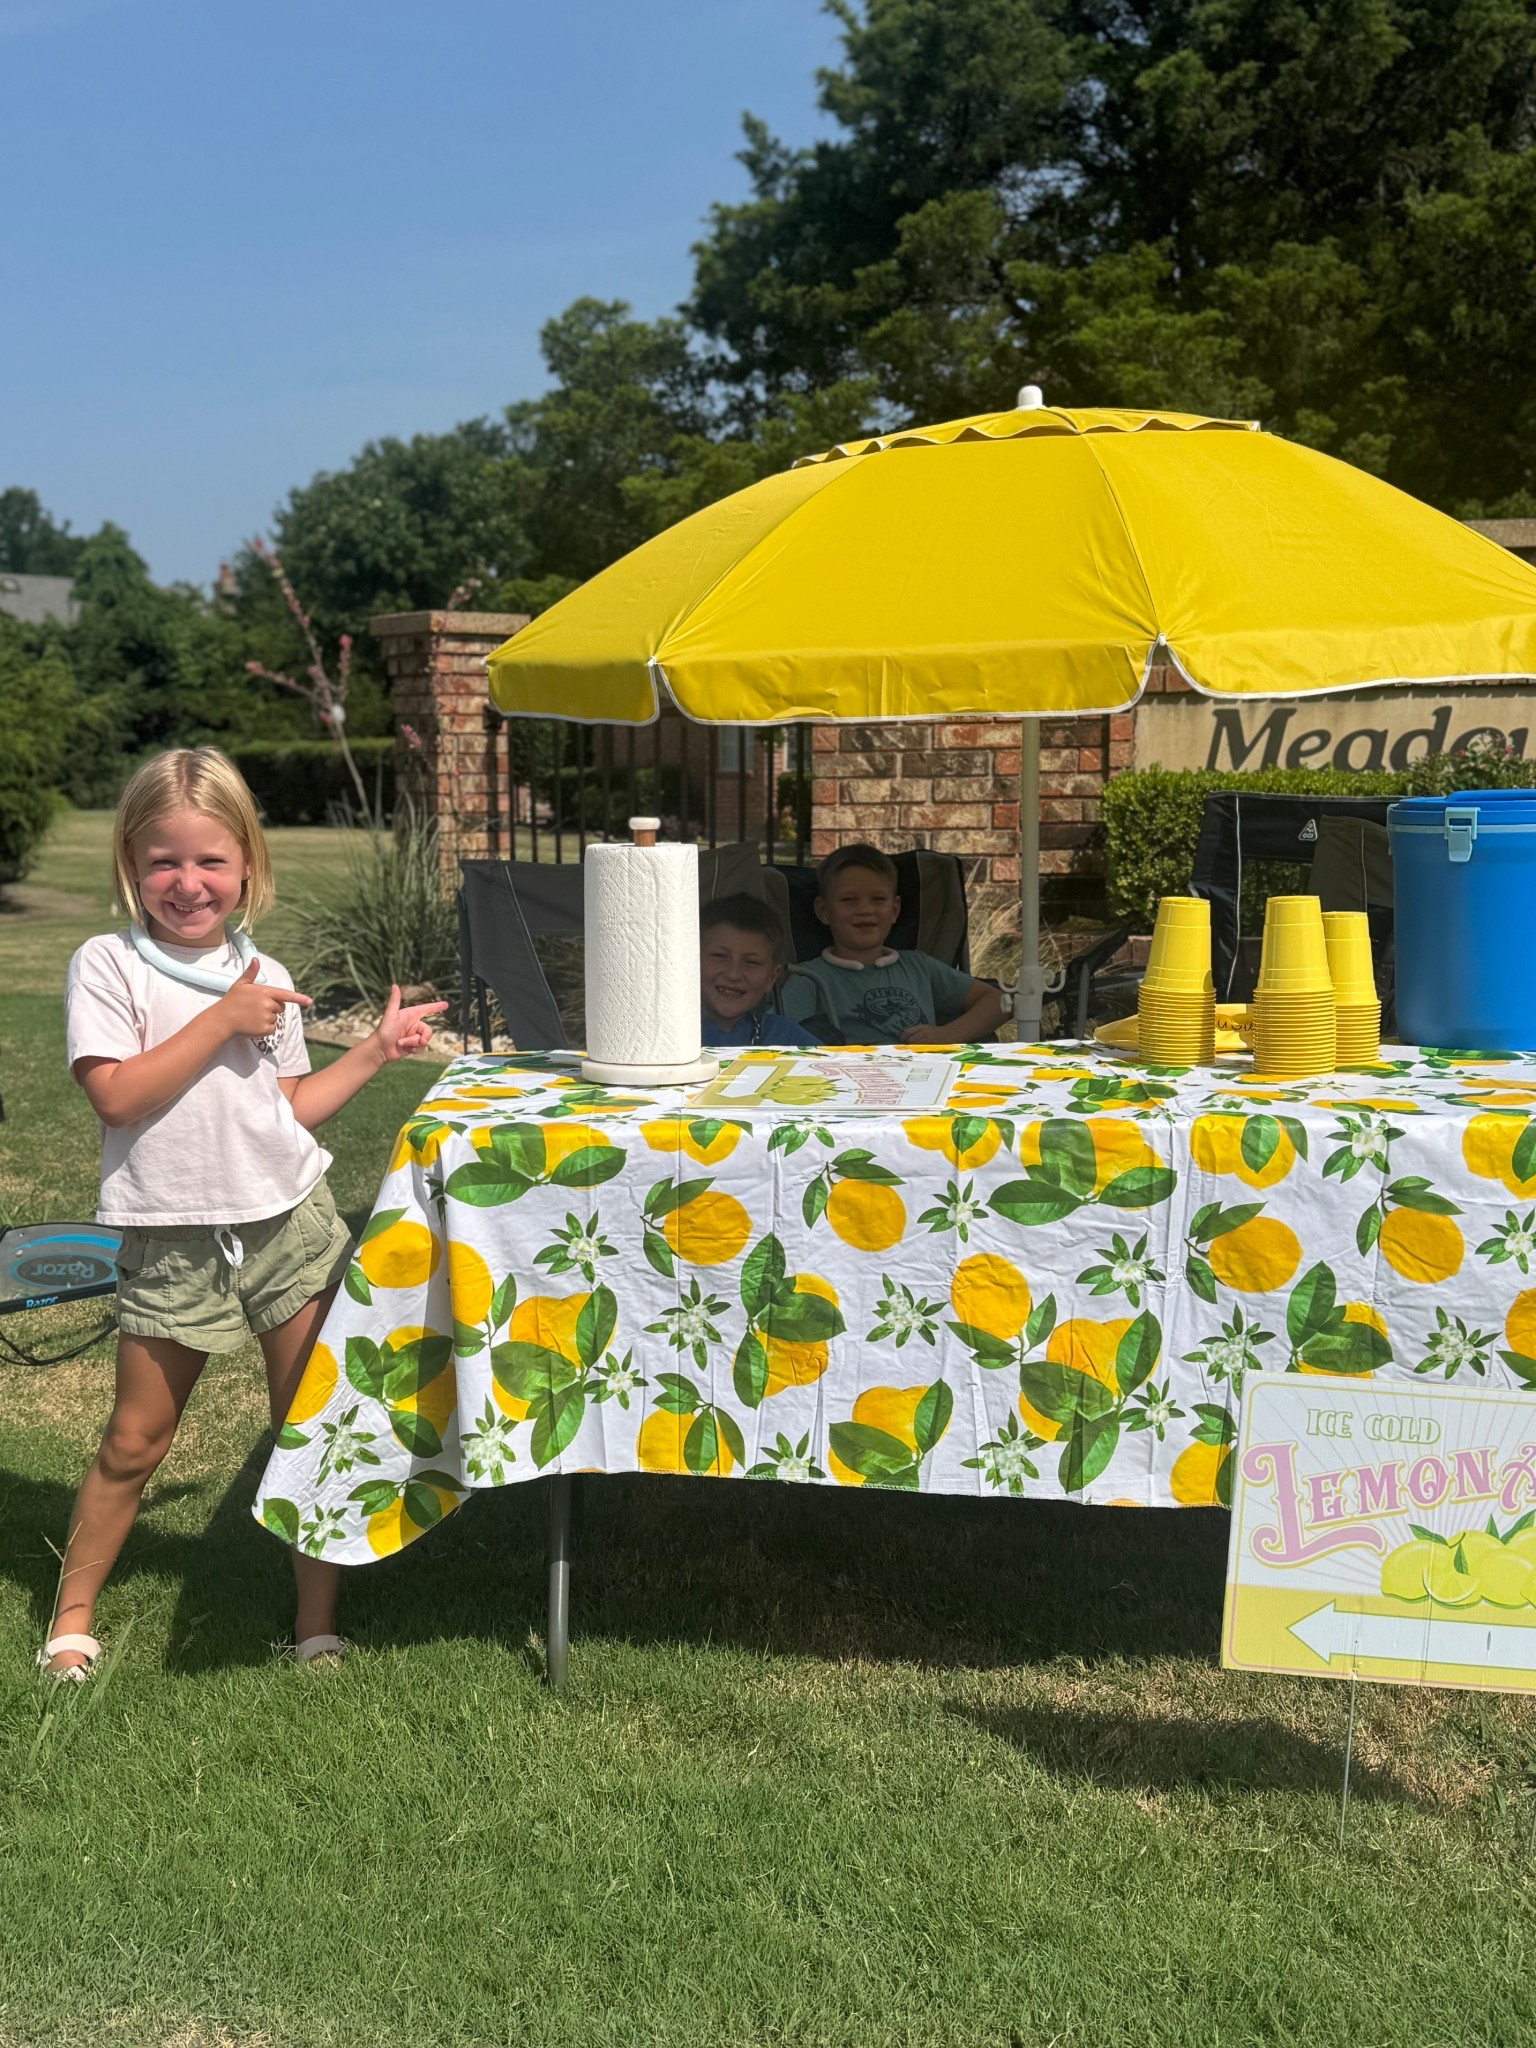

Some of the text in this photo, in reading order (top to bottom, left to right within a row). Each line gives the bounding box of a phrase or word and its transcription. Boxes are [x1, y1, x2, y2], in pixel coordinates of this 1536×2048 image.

[31, 1263, 95, 1279] Razor
[26, 1296, 59, 1309] Razor
[1306, 1409, 1441, 1445] ICE COLD
